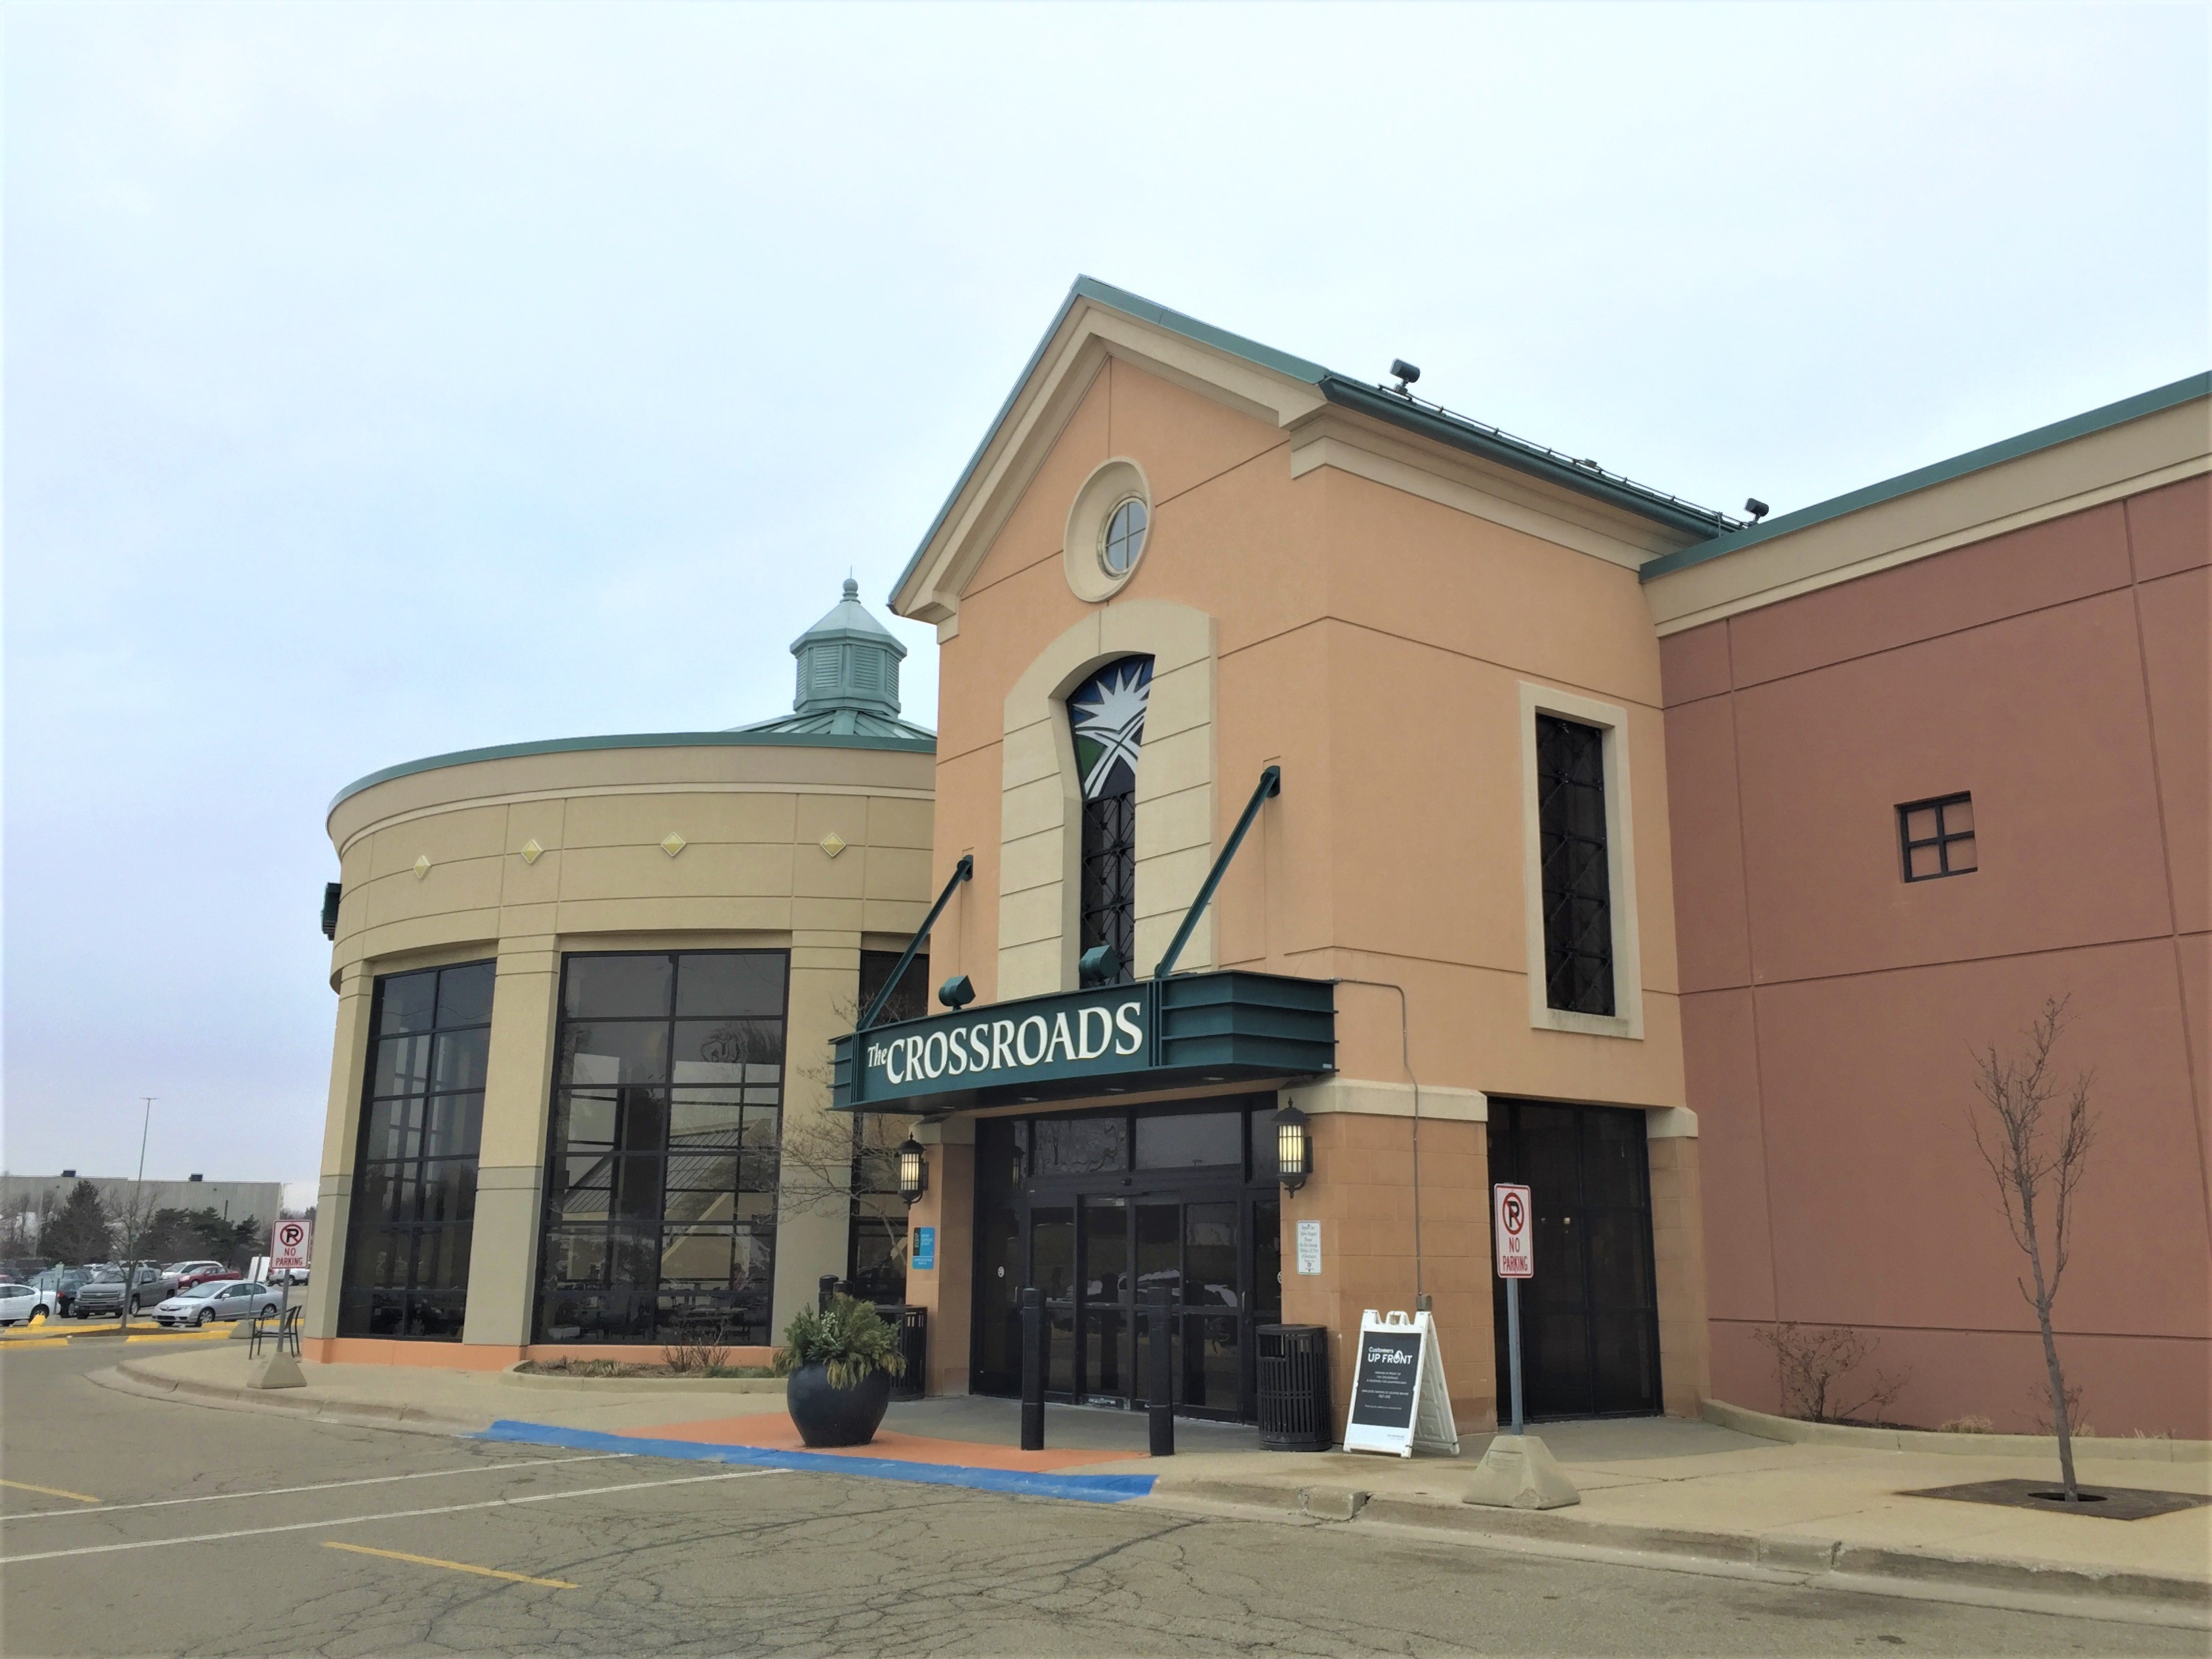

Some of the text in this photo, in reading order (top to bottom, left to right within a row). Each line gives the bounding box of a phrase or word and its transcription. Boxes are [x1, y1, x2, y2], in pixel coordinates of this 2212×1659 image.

[867, 1002, 1143, 1084] The CROSSROADS
[284, 1248, 297, 1256] NO
[1509, 1237, 1520, 1253] NO
[275, 1257, 303, 1267] PARKING
[1502, 1255, 1528, 1271] PARKING
[1368, 1350, 1413, 1364] UP FRONT
